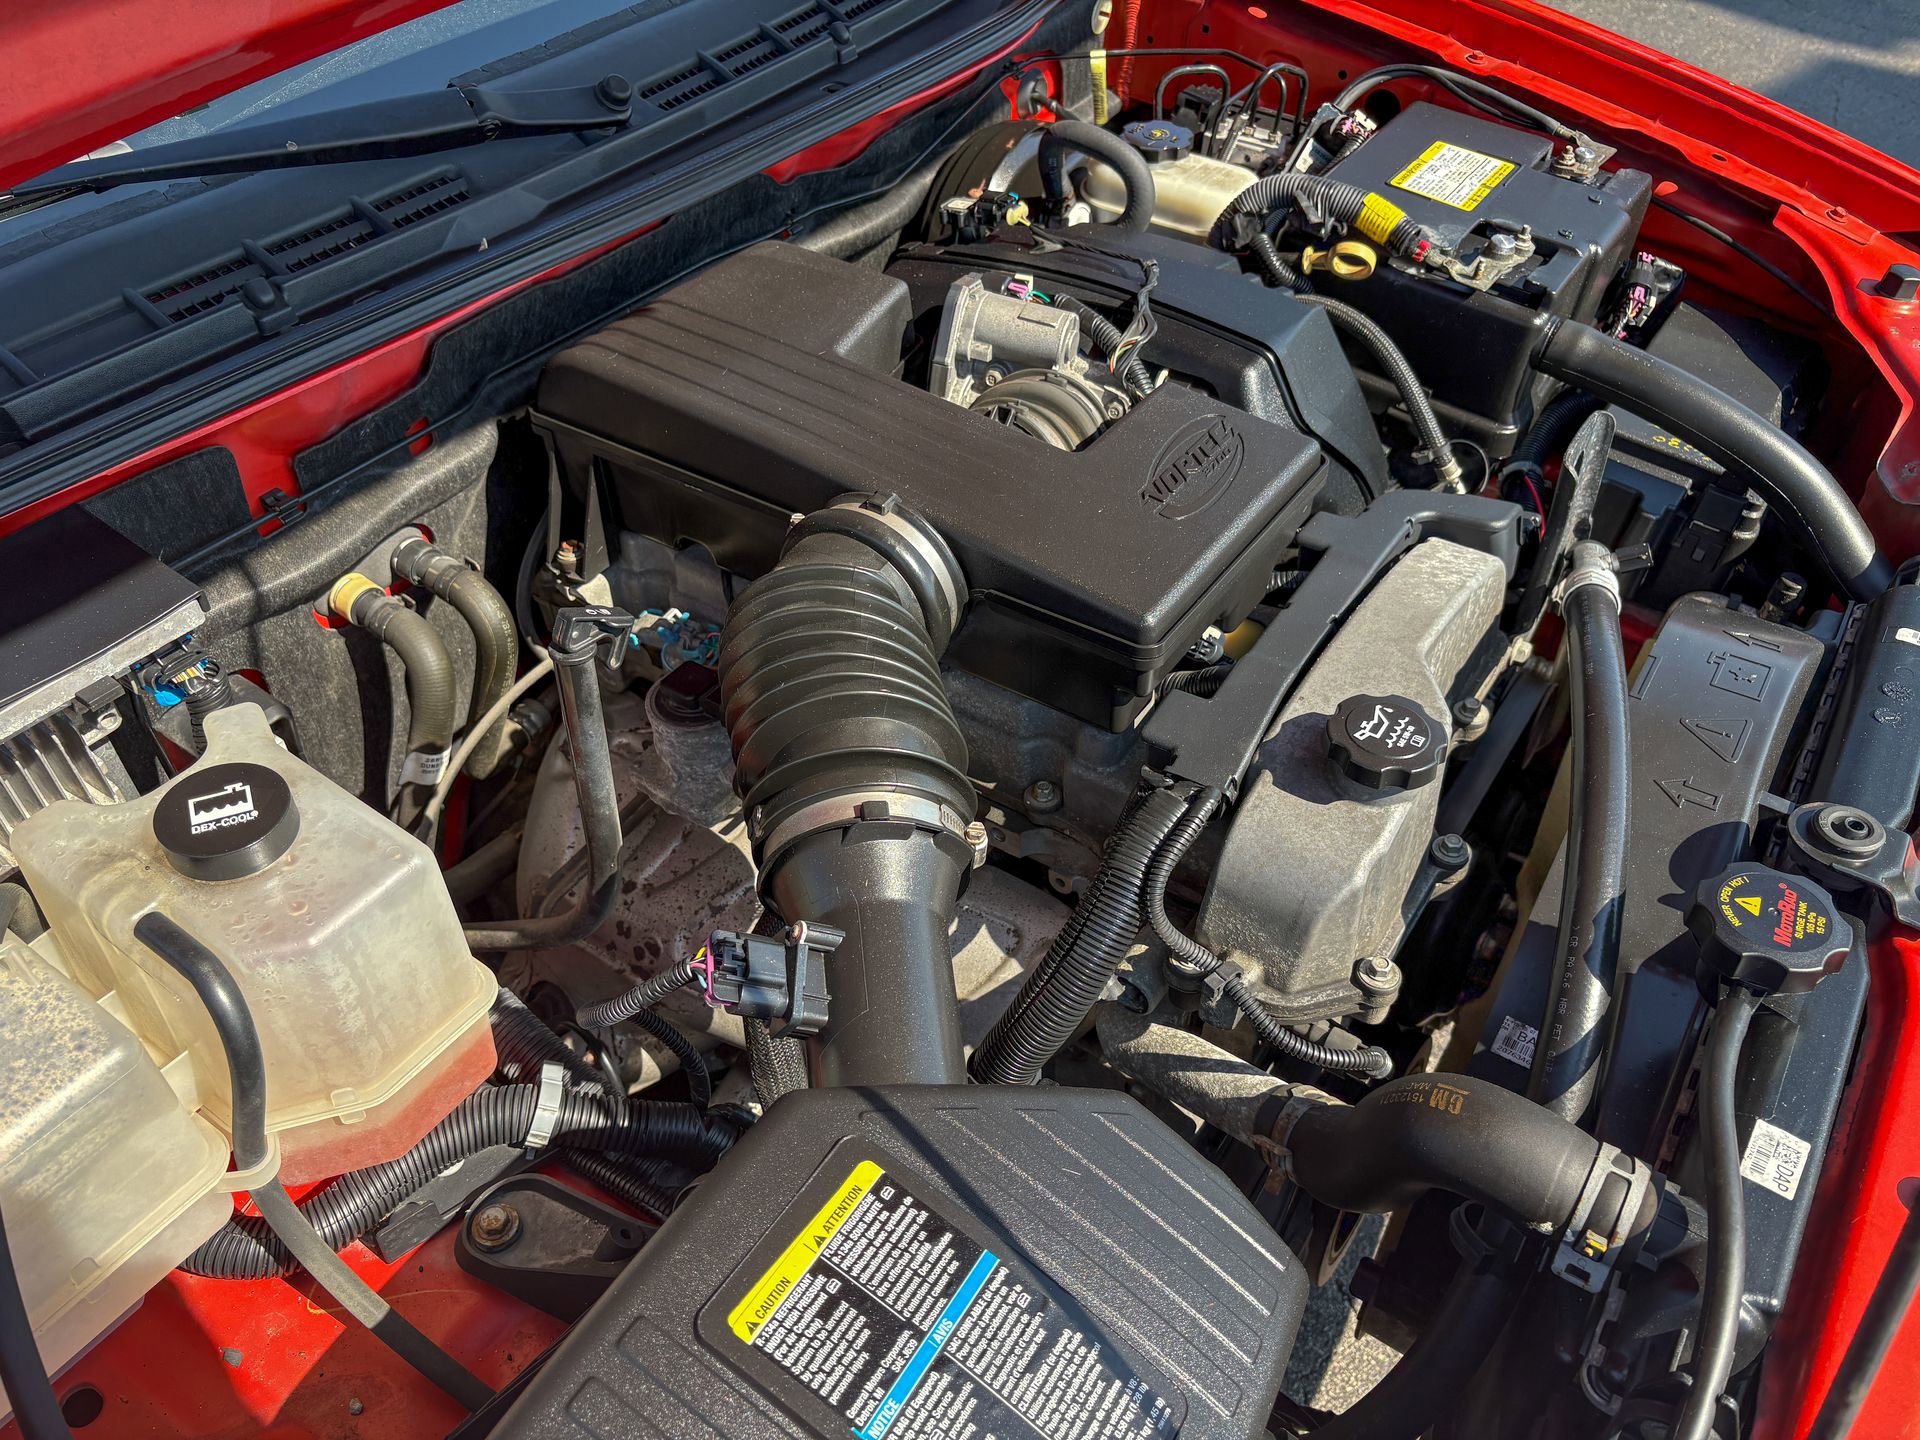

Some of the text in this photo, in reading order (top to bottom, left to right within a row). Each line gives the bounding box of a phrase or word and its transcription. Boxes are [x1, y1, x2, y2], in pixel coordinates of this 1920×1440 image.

[1140, 419, 1236, 505] VORTEC
[1720, 887, 1734, 903] OPEN
[1721, 903, 1743, 928] NEVER
[1794, 901, 1808, 940] SURGE TANK
[1429, 1088, 1464, 1115] GM
[820, 1184, 862, 1234] ATTENTION
[831, 1199, 883, 1265] R-134a SOUS HAUTE
[849, 1194, 913, 1278] véhicules avec système de
[890, 1209, 928, 1258] du système doit
[822, 1232, 845, 1258] FLUIDE
[840, 1208, 889, 1271] PRESSION (pour les
[857, 1206, 918, 1284] climatisation seulement)
[875, 1230, 927, 1297] être effectué par un
[925, 1246, 955, 1284] incorrectes
[753, 1275, 791, 1320] CAUTION
[884, 1240, 933, 1305] personnel qualifié
[893, 1230, 953, 1311] seulement. Des méthodes
[910, 1258, 960, 1326] peuvent causer des
[754, 1272, 814, 1347] R-134a REFRIGERANT
[763, 1273, 827, 1354] UNDER HIGH PRESSURE
[773, 1291, 828, 1362] (For Air Conditioned
[790, 1299, 849, 1376] System to be serviced
[919, 1294, 948, 1332] blessures.
[930, 1316, 954, 1344] AVIS
[946, 1335, 962, 1354] SAC
[956, 1297, 987, 1339] GONFLABLE
[981, 1288, 994, 1302] (si
[955, 1285, 1009, 1360] Pour aider à prévenir un
[964, 1282, 1023, 1369] gonflage accidentel, voir le
[781, 1316, 824, 1368] Vehicles Only)
[800, 1306, 859, 1383] by qualified personnel
[809, 1314, 866, 1390] only. Improper service
[818, 1327, 871, 1397] methods may cause
[973, 1305, 1022, 1375] Manuel de réparation
[983, 1311, 1030, 1383] pour les méthodes de
[990, 1345, 1022, 1391] diagnostic et
[999, 1327, 1046, 1397] avant tout
[827, 1349, 871, 1405] personal injury.
[845, 1326, 913, 1419] General Motors Corporation,
[854, 1338, 918, 1427] Detroit, MI SAE J639
[892, 1415, 910, 1436] BAG
[909, 1369, 941, 1410] Equipped)
[944, 1379, 975, 1419] diagnostic
[1008, 1369, 1034, 1404] entretien.
[1016, 1362, 1051, 1412] CLIMATISEUR
[1045, 1352, 1058, 1366] (si
[1026, 1330, 1083, 1420] Utiliser seulement le fluide
[1034, 1344, 1087, 1428] frigorigène R-134a et de
[1064, 1361, 1104, 1422] PAG). Le système
[1078, 1378, 1107, 1421] du colorant.
[1094, 1377, 1124, 1421] du système
[1122, 1409, 1134, 1423] kg
[1137, 1381, 1149, 1394] lb)
[866, 1397, 900, 1440] NOTICE
[909, 1407, 929, 1431] avoid
[923, 1389, 954, 1433] see Service
[938, 1415, 951, 1430] for
[946, 1395, 979, 1439] procedures
[1057, 1401, 1068, 1413] au
[1102, 1422, 1113, 1436] les
[1107, 1392, 1131, 1426] véhicules
[1139, 1424, 1152, 1438] kg
[1154, 1395, 1166, 1409] lb)
